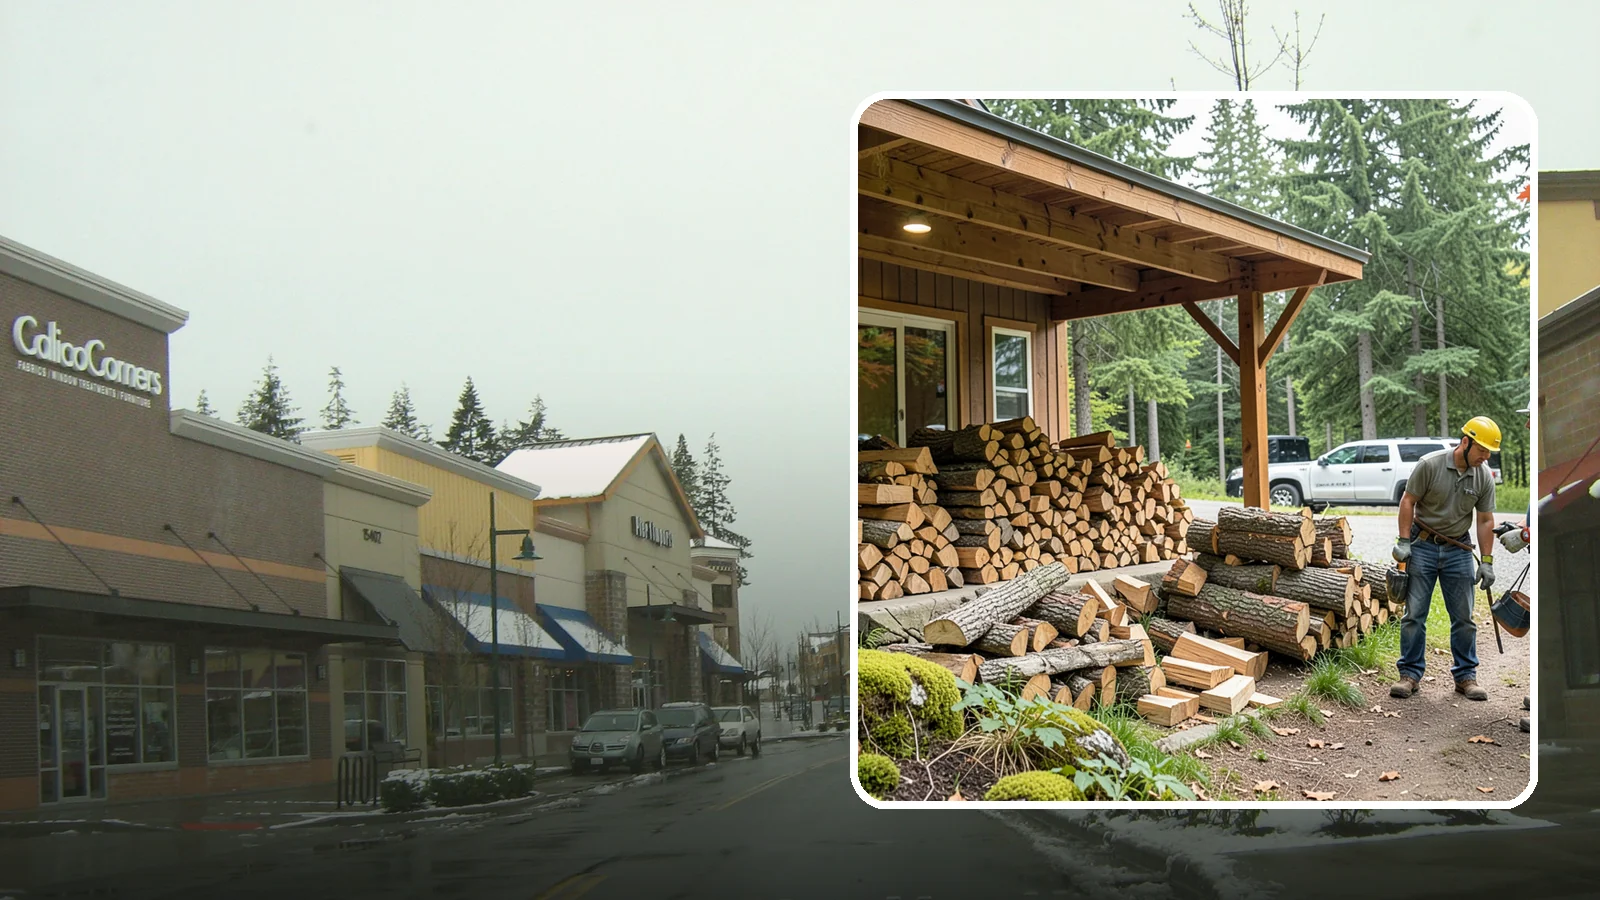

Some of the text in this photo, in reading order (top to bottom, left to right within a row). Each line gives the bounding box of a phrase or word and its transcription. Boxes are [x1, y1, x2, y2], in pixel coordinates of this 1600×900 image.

[16, 360, 151, 409] FABRICS WINDOW TREATMENTS FURNITURE
